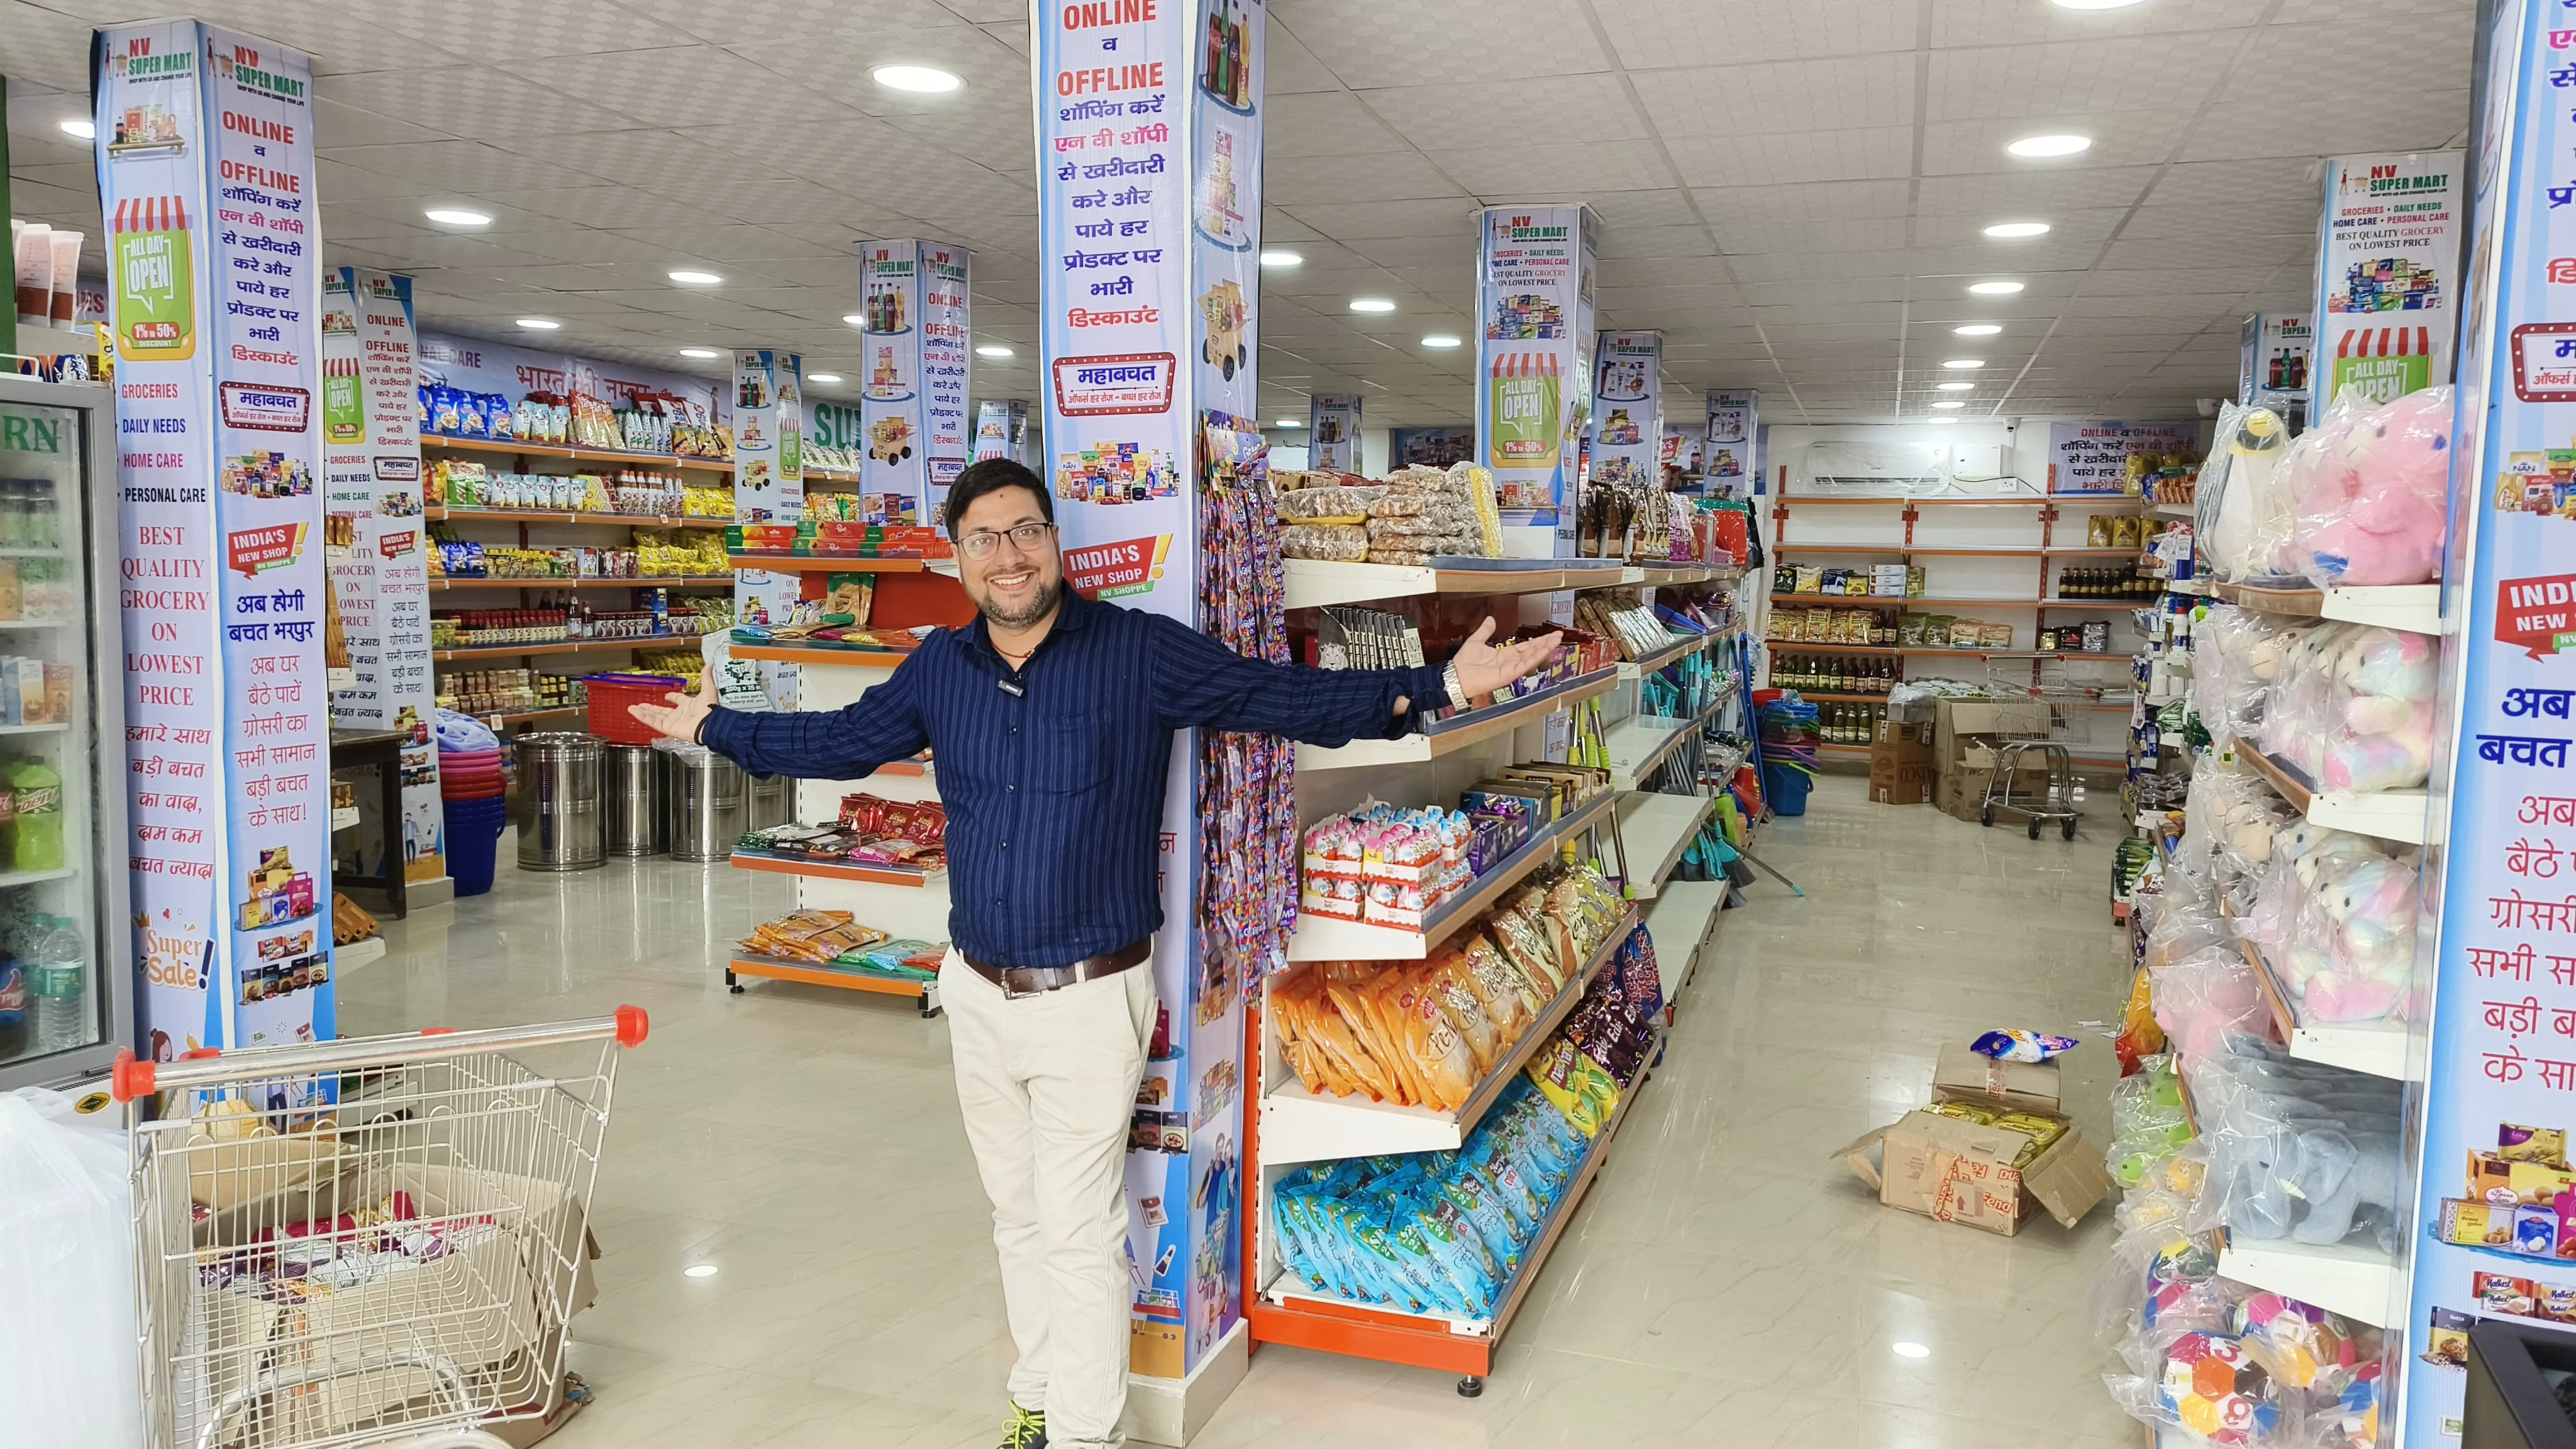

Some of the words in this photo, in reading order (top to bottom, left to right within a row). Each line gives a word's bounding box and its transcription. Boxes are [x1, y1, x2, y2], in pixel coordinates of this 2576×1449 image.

[1064, 0, 1156, 30] ONLINE
[130, 38, 150, 57] NV
[1102, 36, 1118, 52] व
[129, 56, 161, 75] SUPER
[164, 52, 192, 70] MART
[235, 45, 258, 67] NV
[235, 65, 271, 89] SUPER
[274, 77, 304, 97] MART
[1057, 62, 1163, 97] OFFLINE
[1059, 99, 1123, 121] शॉपिंग
[1129, 94, 1166, 115] करें
[223, 111, 294, 145] ONLINE
[1054, 135, 1086, 153] एन
[1092, 128, 1114, 148] वी
[1120, 123, 1169, 145] शॉपी
[254, 145, 265, 157] व
[220, 160, 299, 193] OFFLINE
[1057, 161, 1077, 181] से
[1082, 153, 1165, 180] खरीदारी
[2371, 165, 2397, 179] NV
[2370, 178, 2409, 192] SUPER
[2412, 174, 2448, 189] MART
[222, 187, 272, 206] शॉपिंग
[276, 196, 302, 212] करें
[1072, 189, 1108, 209] करे
[1111, 186, 1153, 206] और
[2341, 206, 2384, 216] GROCERIES
[2394, 203, 2414, 213] DAILY
[2417, 202, 2442, 211] NEEDS
[218, 209, 243, 223] एन
[248, 212, 265, 227] वी
[269, 217, 304, 235] शॉपी
[1075, 218, 1113, 238] पाये
[1120, 219, 1149, 237] हर
[1513, 216, 1531, 226] NV
[2333, 218, 2355, 228] HOME
[2358, 217, 2377, 226] CARE
[2387, 214, 2426, 224] PERSONAL
[2429, 213, 2449, 221] CARE
[1512, 227, 1540, 238] SUPER
[1543, 226, 1568, 237] MART
[2336, 232, 2357, 240] BEST
[2359, 230, 2399, 240] QUALITY
[2401, 226, 2445, 236] GROCERY
[131, 238, 146, 255] ALL
[147, 235, 165, 254] DAY
[222, 231, 238, 246] से
[242, 233, 302, 257] खरीदारी
[2349, 242, 2362, 250] ON
[2364, 240, 2401, 249] LOWEST
[2403, 238, 2429, 247] PRICE
[233, 255, 260, 272] करे
[264, 262, 292, 277] और
[1063, 249, 1128, 272] प्रोडक्ट
[1134, 248, 1162, 265] पर
[130, 256, 169, 291] OPEN
[236, 278, 266, 294] पाये
[270, 284, 290, 299] हर
[1090, 275, 1133, 297] भारी
[227, 300, 277, 319] प्रोडक्ट
[279, 308, 299, 322] पर
[367, 314, 404, 327] ONLINE
[1067, 304, 1159, 328] डिस्काउंट
[135, 325, 148, 338] 1%
[157, 323, 177, 338] 50%
[248, 327, 280, 341] भारी
[231, 345, 298, 365] डिस्काउंट
[366, 341, 409, 353] OFFLINE
[1077, 364, 1157, 386] महाबचत
[2355, 362, 2373, 377] ALL
[2377, 360, 2399, 375] DAY
[2534, 371, 2570, 385] ऑफर्स
[516, 365, 564, 394] भारत
[1505, 381, 1519, 394] ALL
[1522, 380, 1537, 394] DAY
[122, 384, 177, 398] GROCERIES
[240, 392, 297, 408] महाबचत
[1069, 391, 1089, 404] ऑफर्स
[1090, 392, 1100, 403] हर
[1101, 391, 1114, 402] रोज
[1121, 391, 1136, 402] बचत
[1138, 392, 1148, 402] हर
[1149, 390, 1162, 401] रोज
[1505, 396, 1540, 419] OPEN
[123, 419, 150, 433] DAILY
[153, 419, 186, 433] NEEDS
[2081, 428, 2117, 437] ONLINE
[2121, 429, 2130, 437] व
[2061, 440, 2098, 450] शॉपिंग
[2102, 440, 2124, 450] करें
[124, 454, 152, 467] HOME
[157, 454, 182, 468] CARE
[331, 455, 365, 464] GROCERIES
[2513, 464, 2536, 473] NAN
[349, 474, 370, 482] NEEDS
[125, 488, 177, 502] PERSONAL
[180, 488, 206, 502] CARE
[139, 526, 184, 545] BEST
[233, 529, 286, 549] INDIA'S
[238, 550, 258, 563] NEW
[262, 547, 288, 560] SHOP
[1070, 545, 1140, 572] INDIA'S
[122, 558, 204, 580] QUALITY
[1074, 574, 1104, 589] NEW
[1108, 568, 1143, 585] SHOP
[121, 590, 209, 610] GROCERY
[1100, 589, 1111, 597] NV
[1114, 584, 1148, 595] SHOPPE
[237, 594, 267, 613] अब
[272, 589, 305, 611] होगी
[152, 623, 177, 641] ON
[228, 623, 269, 642] बचत
[2516, 614, 2566, 632] NEW
[128, 655, 203, 674] LOWEST
[251, 658, 275, 675] अब
[279, 655, 299, 672] घर
[140, 686, 194, 706] PRICE
[248, 682, 270, 705] बैठे
[274, 680, 302, 702] पायें
[2502, 687, 2575, 719] अब
[125, 723, 167, 742] हमारे
[172, 728, 211, 745] साथ
[242, 714, 284, 738] ग्रोसरी
[287, 713, 308, 733] का
[235, 745, 265, 768] सभी
[270, 743, 316, 762] सामान
[2477, 735, 2572, 768] बचत
[247, 776, 271, 801] बड़ी
[274, 774, 308, 794] बचत
[138, 792, 160, 807] का
[248, 805, 267, 828] के
[137, 824, 168, 841] दाम
[170, 828, 203, 844] कम
[2506, 838, 2563, 879] बैठे
[169, 860, 214, 879] ज्यादा
[147, 930, 202, 957] Super
[2467, 942, 2537, 981] सभी
[2482, 998, 2541, 1039] बड़ी
[2482, 1045, 2528, 1084] के
